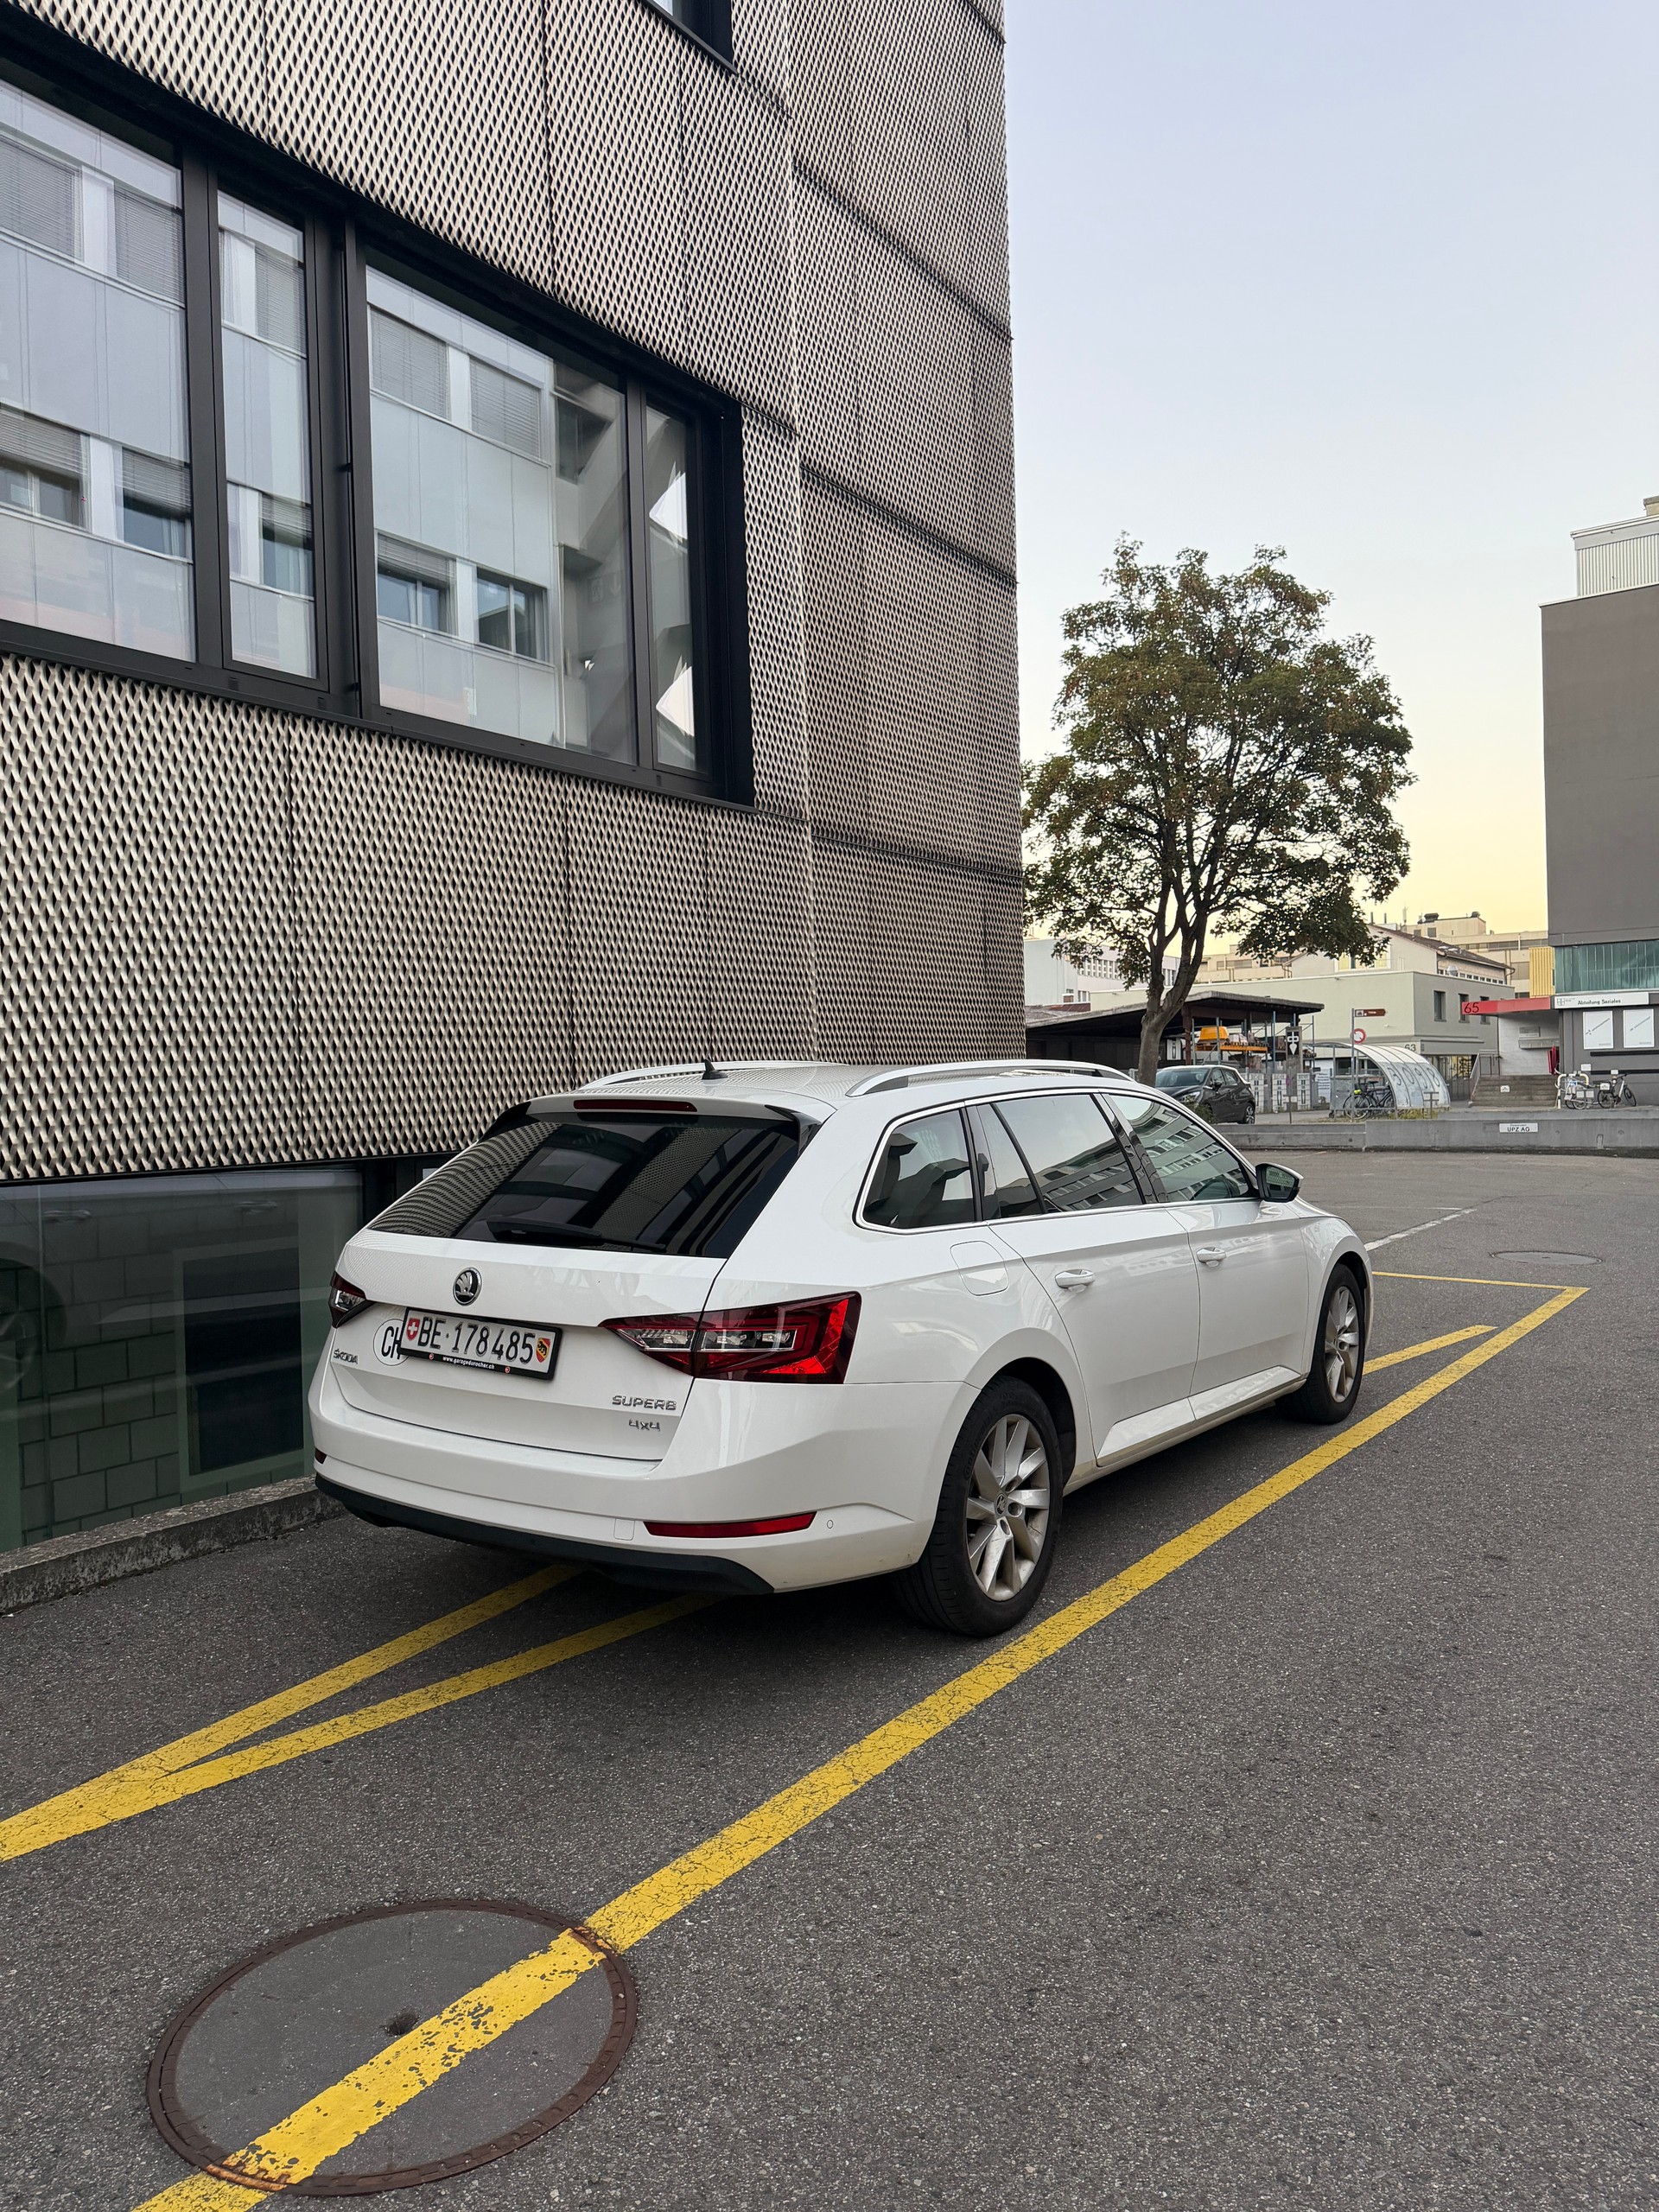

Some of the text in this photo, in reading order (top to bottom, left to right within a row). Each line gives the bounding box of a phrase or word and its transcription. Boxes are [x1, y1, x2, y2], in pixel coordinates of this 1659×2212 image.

[1464, 1002, 1479, 1014] 65
[381, 1326, 401, 1359] CH
[442, 1356, 495, 1370] www.garagedurocher.ch
[612, 1395, 677, 1410] SUPERB
[628, 1419, 661, 1432] 4x4
